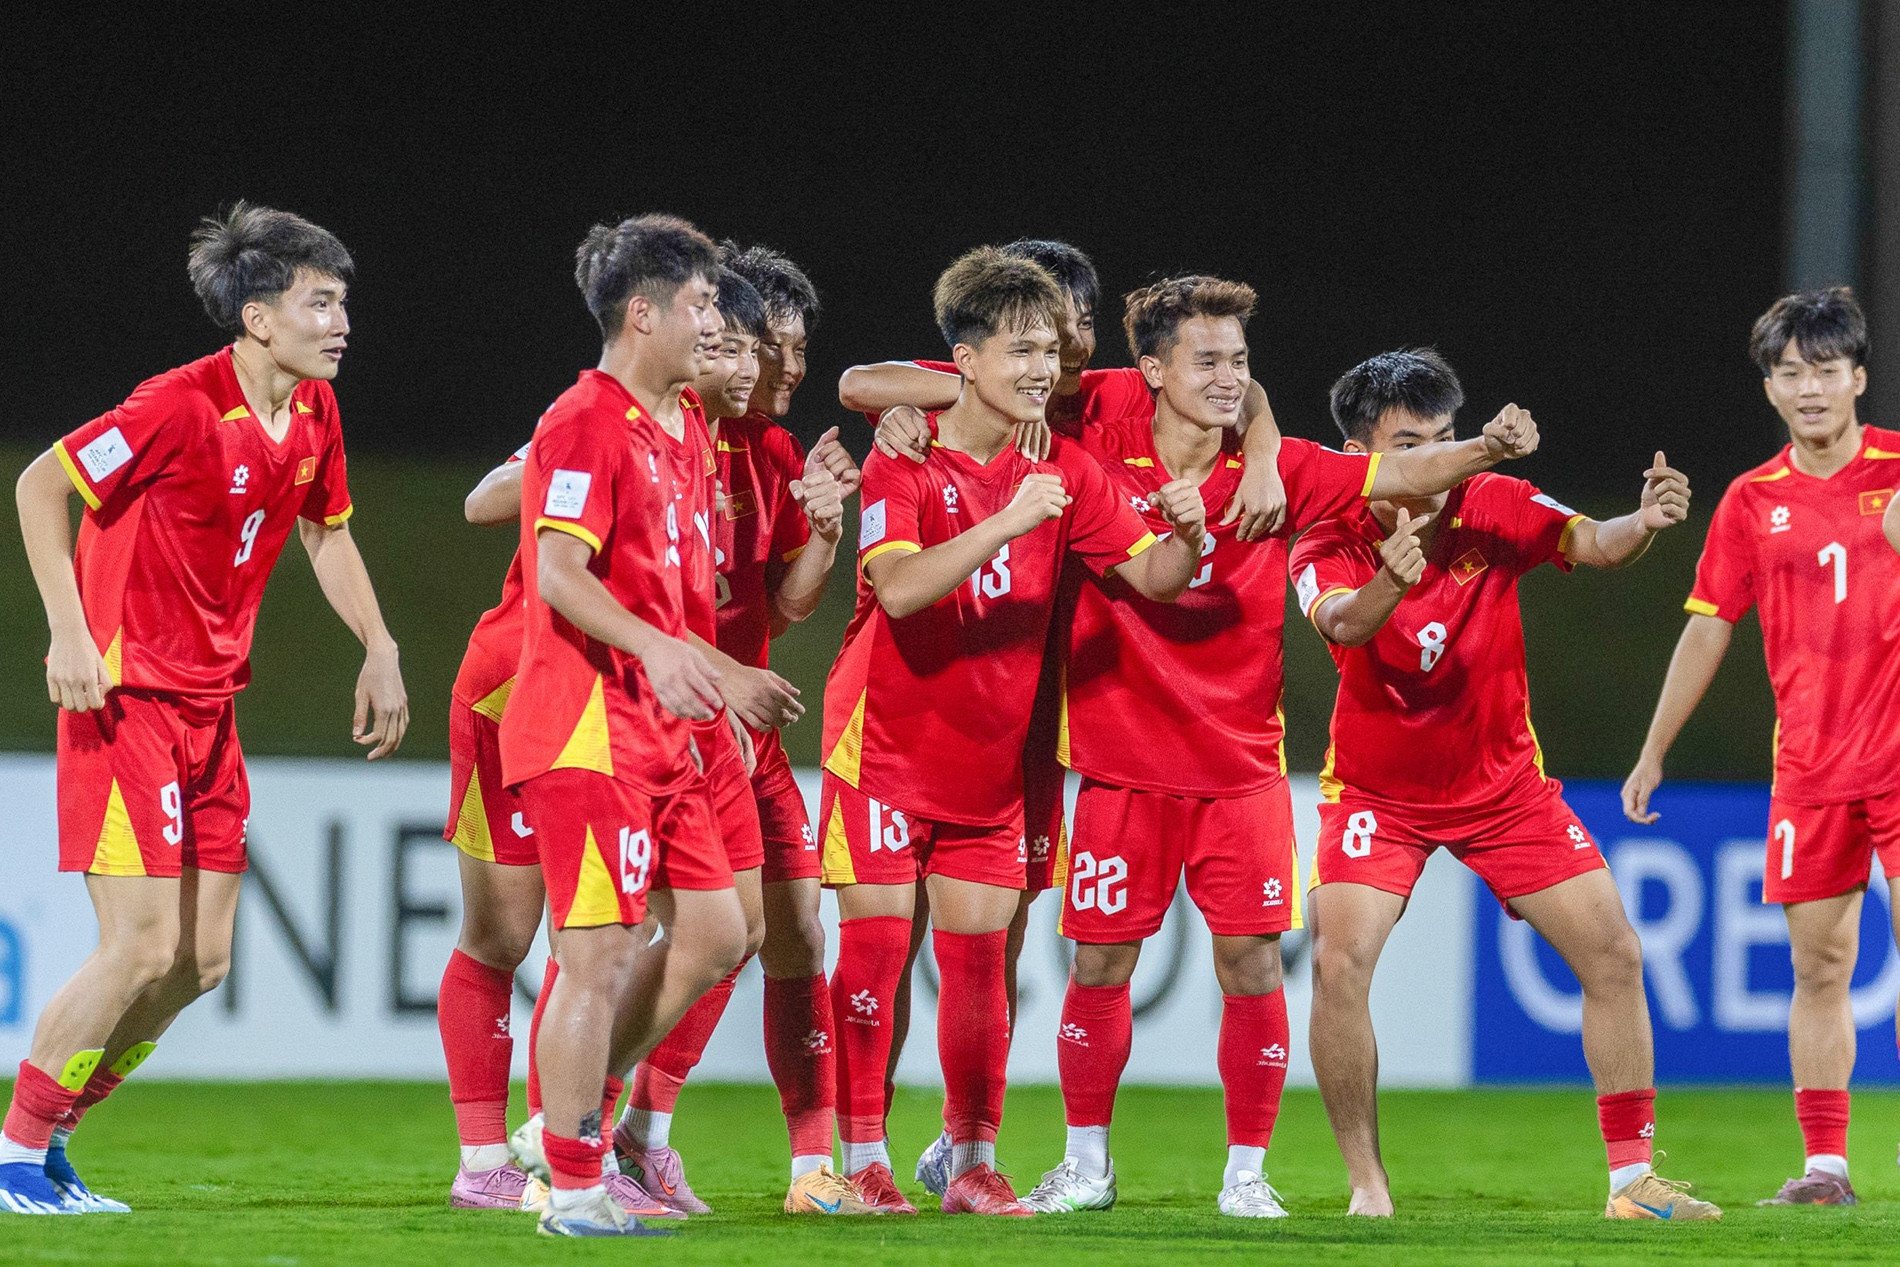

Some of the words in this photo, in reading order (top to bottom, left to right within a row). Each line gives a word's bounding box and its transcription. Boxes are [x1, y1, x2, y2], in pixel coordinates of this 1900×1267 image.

[234, 509, 265, 568] 9
[1416, 621, 1447, 672] 8
[160, 780, 184, 846] 9
[869, 797, 910, 853] 13
[1341, 810, 1378, 859] 8
[619, 826, 652, 895] 19
[1071, 850, 1128, 916] 22
